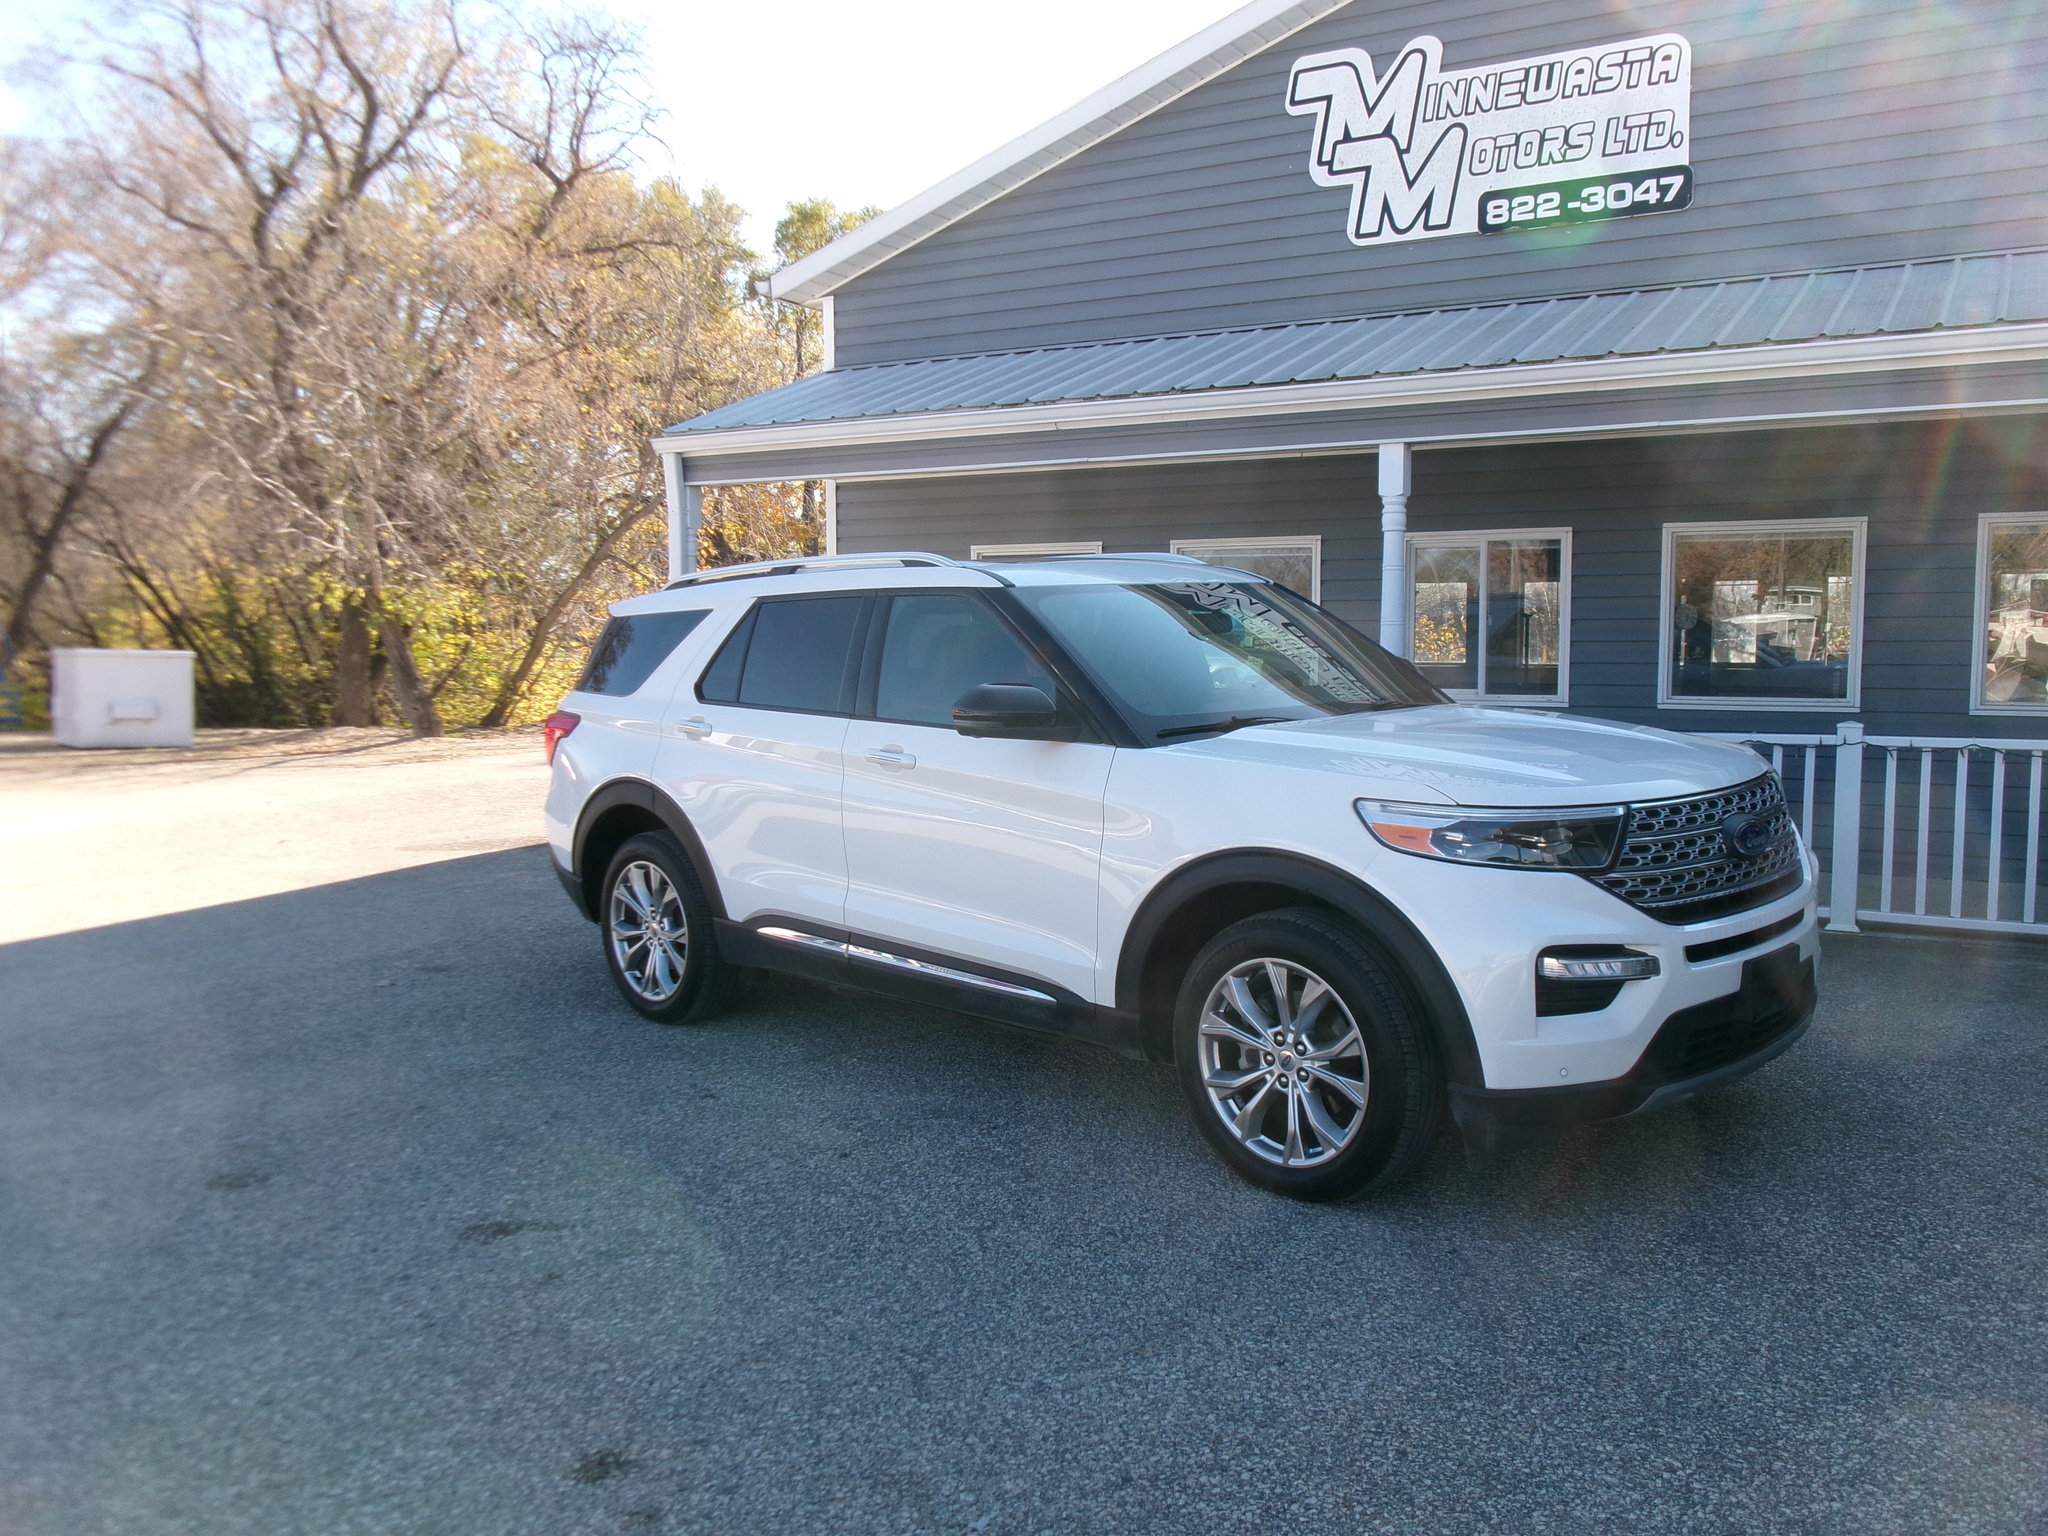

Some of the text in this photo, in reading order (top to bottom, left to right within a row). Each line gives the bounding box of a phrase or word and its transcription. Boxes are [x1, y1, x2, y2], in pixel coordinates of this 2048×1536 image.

[1289, 43, 1682, 166] MINNEWASTA
[1328, 109, 1684, 238] MOTORS LTD.
[1486, 175, 1685, 225] 822-3047
